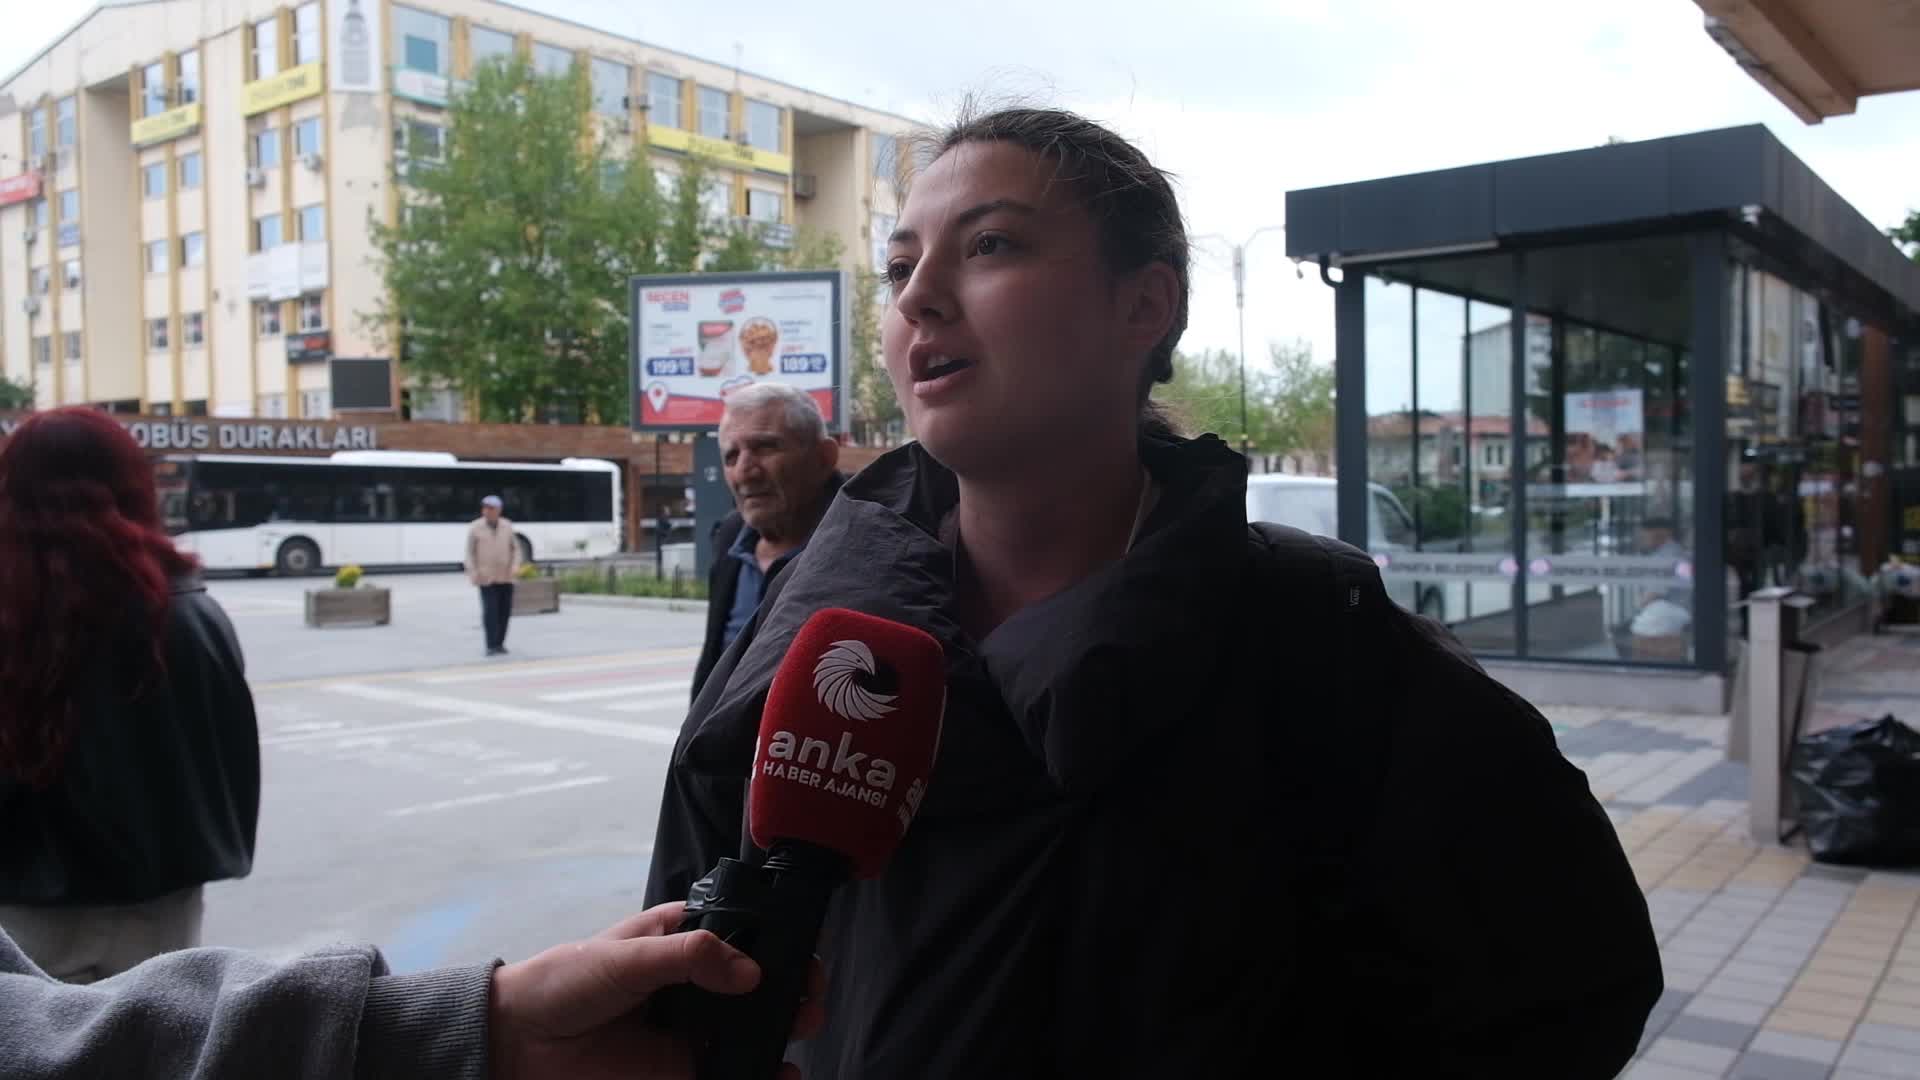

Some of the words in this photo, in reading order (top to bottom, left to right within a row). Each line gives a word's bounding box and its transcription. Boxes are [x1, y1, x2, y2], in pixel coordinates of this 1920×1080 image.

[123, 416, 209, 449] OBÜS
[219, 424, 377, 449] DURAKLARI
[762, 760, 821, 788] HABER
[824, 778, 888, 808] AJANSI
[768, 730, 896, 791] anka
